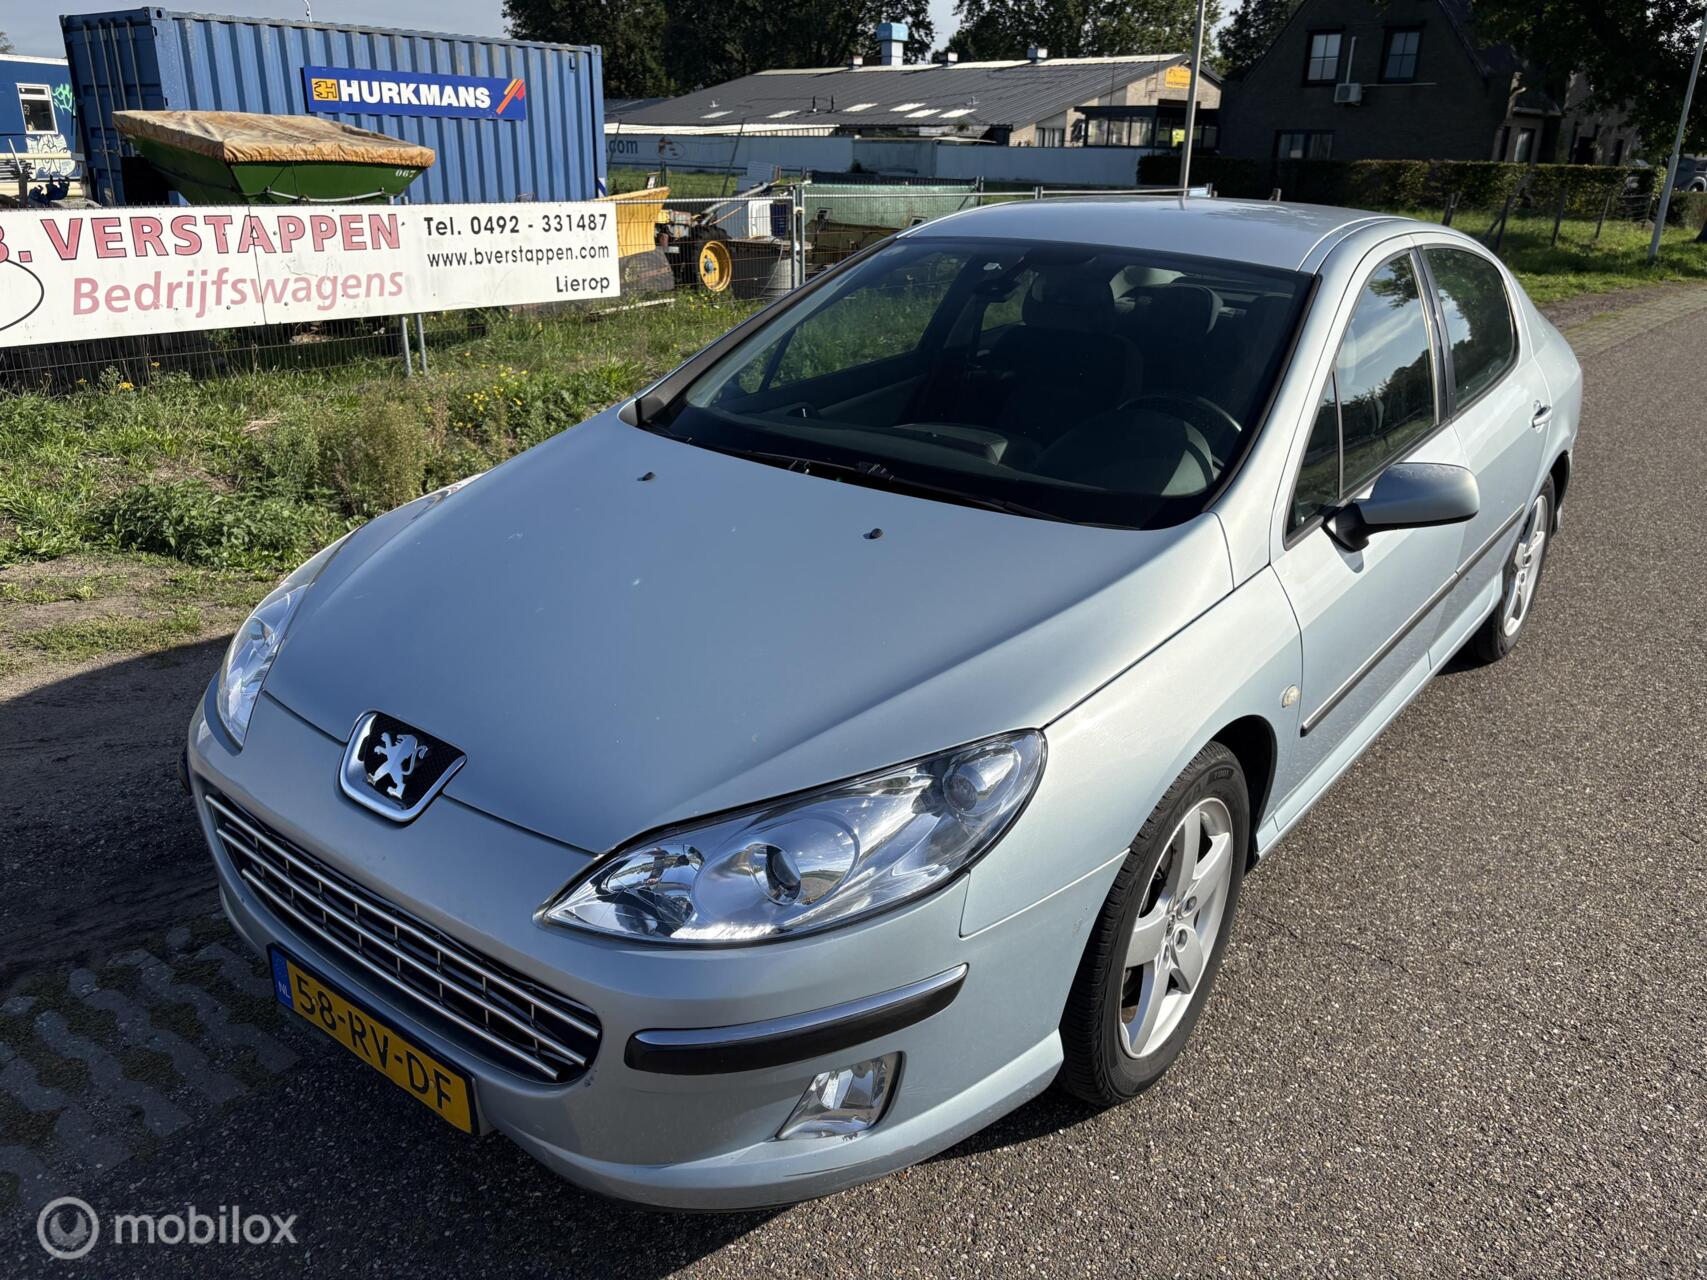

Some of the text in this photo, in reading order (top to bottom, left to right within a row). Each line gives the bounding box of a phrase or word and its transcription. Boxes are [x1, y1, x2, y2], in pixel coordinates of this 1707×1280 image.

[340, 79, 491, 108] HURKMANS
[40, 213, 401, 261] VERSTAPPEN
[424, 216, 461, 236] Tel.
[470, 215, 520, 234] 0492
[542, 213, 608, 233] 331487
[427, 244, 610, 268] www.bverstappen.com
[73, 266, 404, 319] Bedrijfswagens
[556, 275, 611, 294] Lierop
[278, 974, 452, 1110] NL 58-RV-DF
